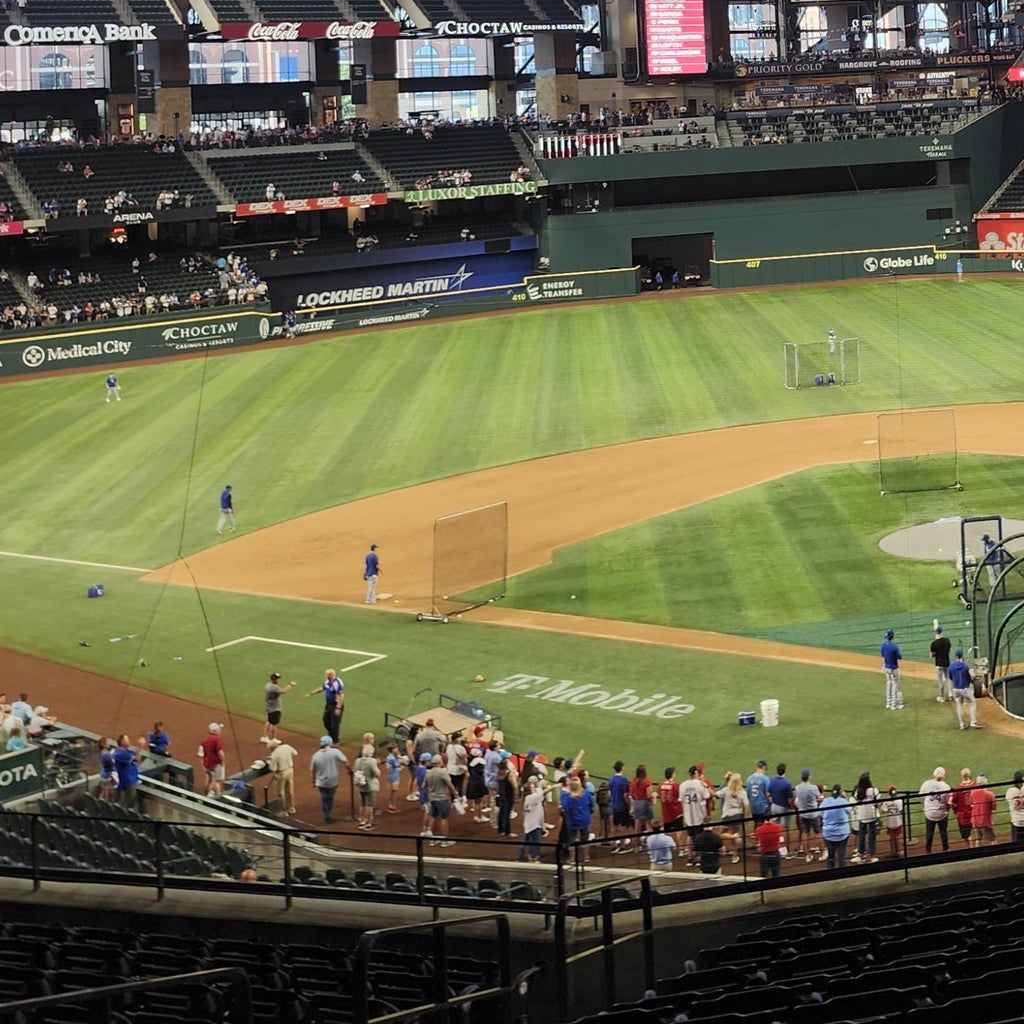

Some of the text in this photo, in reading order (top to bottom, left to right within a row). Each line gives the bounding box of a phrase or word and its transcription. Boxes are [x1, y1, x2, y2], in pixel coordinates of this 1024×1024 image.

[104, 23, 157, 41] Bank
[445, 20, 523, 35] CHOCTAW
[839, 58, 921, 69] HARGROVE ROOFING
[937, 55, 991, 65] PLUCKERS
[748, 63, 822, 74] PRIORITY GOLD
[919, 144, 953, 152] TEREMANA
[417, 180, 536, 203] LUXOR STAFFING
[284, 199, 308, 209] DEX
[317, 196, 341, 206] DEX
[349, 194, 373, 203] DEX
[249, 202, 274, 212] DEX
[113, 212, 154, 223] ARENA
[880, 255, 934, 269] Globe Life
[935, 253, 947, 261] 410
[746, 260, 760, 268] 407
[543, 280, 575, 290] ENERGY
[298, 277, 449, 308] LOCKHEED MARTIN
[512, 293, 526, 301] 410
[543, 288, 583, 299] TRANSFER
[359, 313, 420, 326] LOCKHEED MARTIN
[170, 321, 238, 339] CHOCTAW
[47, 340, 132, 361] Medical City
[176, 342, 202, 350] CASINOS
[486, 673, 696, 719] T-Mobile
[751, 784, 760, 797] 5
[685, 794, 697, 805] 34
